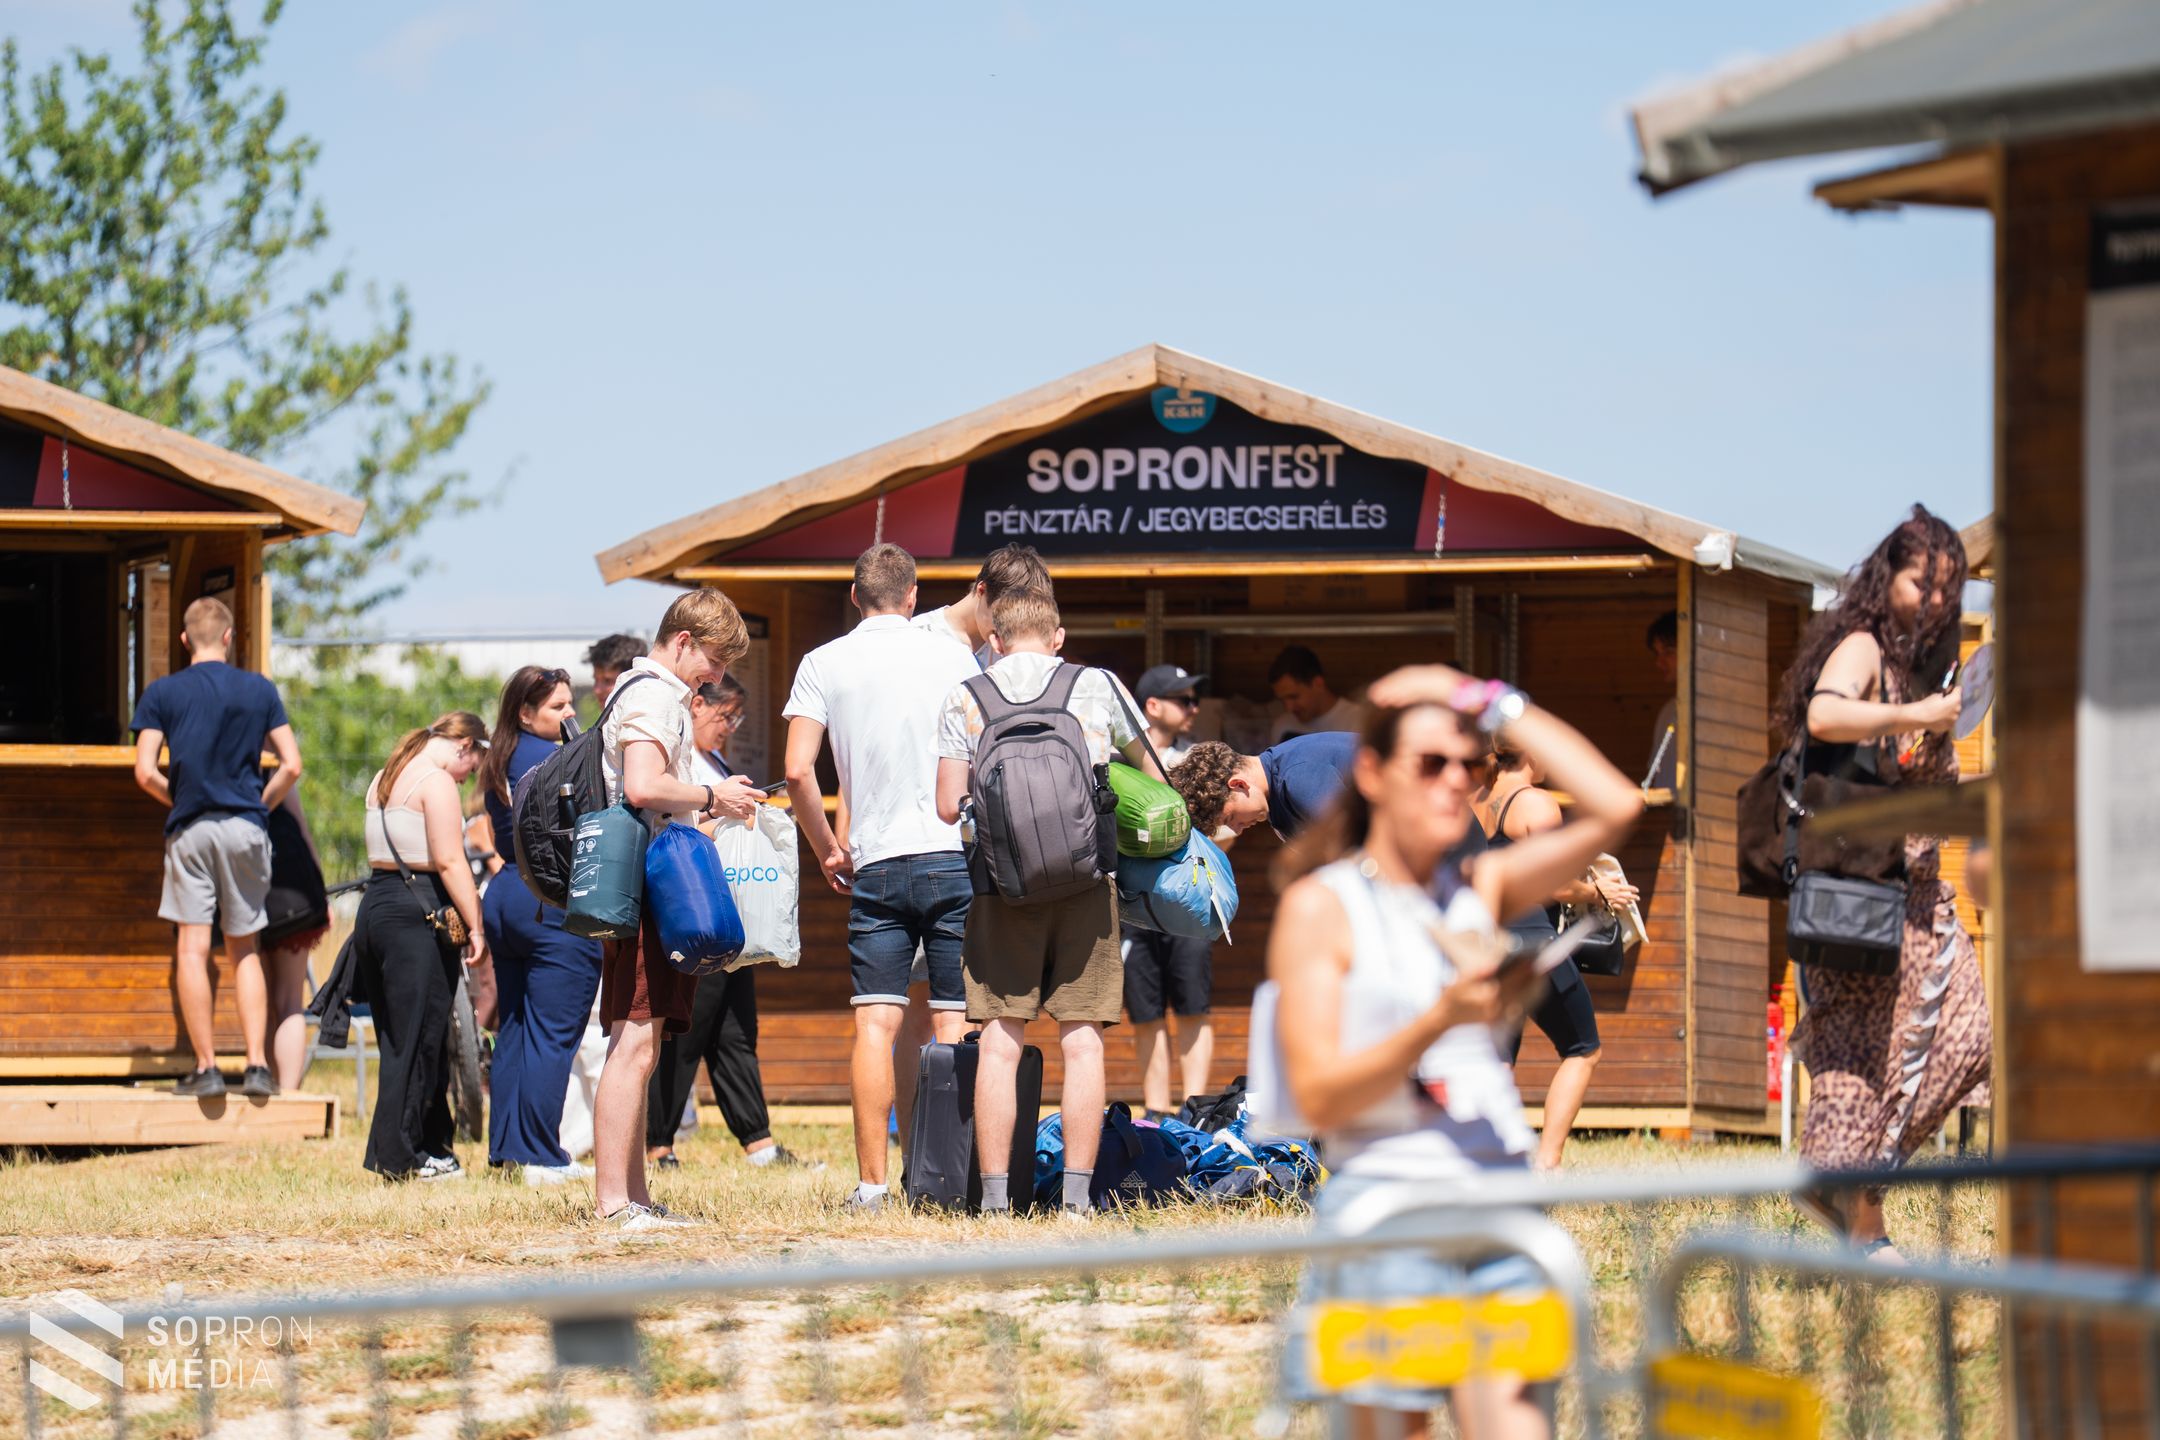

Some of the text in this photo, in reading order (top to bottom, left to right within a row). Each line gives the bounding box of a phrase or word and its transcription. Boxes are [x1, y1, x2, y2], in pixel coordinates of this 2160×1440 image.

[1163, 406, 1205, 418] K&H
[1028, 446, 1343, 491] SOPRONFEST
[985, 501, 1387, 535] PÉNZTÁR / JEGYBECSERÉLÉS
[723, 866, 779, 886] epco
